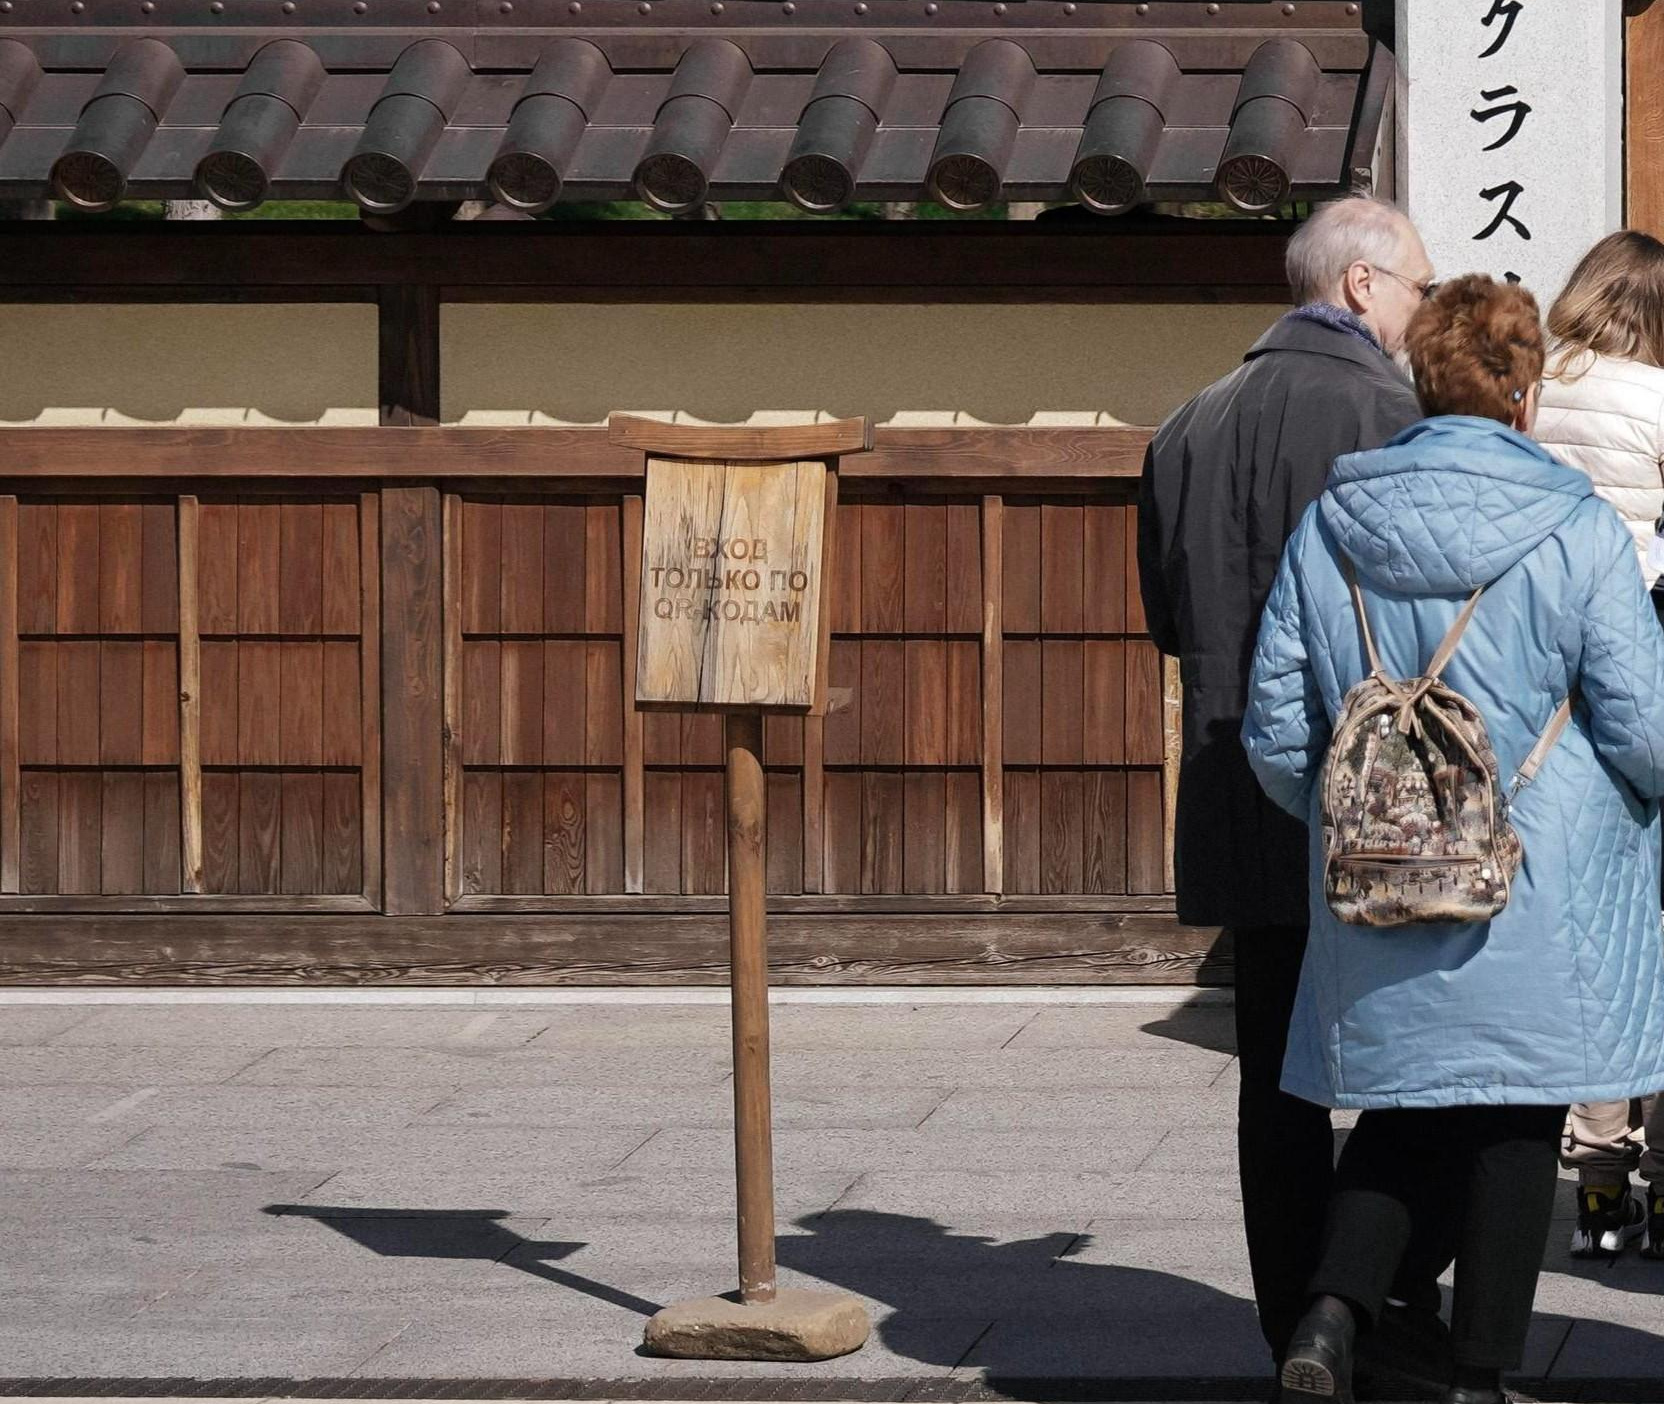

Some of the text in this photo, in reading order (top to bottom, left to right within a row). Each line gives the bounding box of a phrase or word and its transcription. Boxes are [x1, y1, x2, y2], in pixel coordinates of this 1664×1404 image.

[694, 538, 768, 563] ВХОД
[650, 567, 808, 592] ТОЛЬКО ПО
[654, 597, 800, 626] QR-КОДАМ
